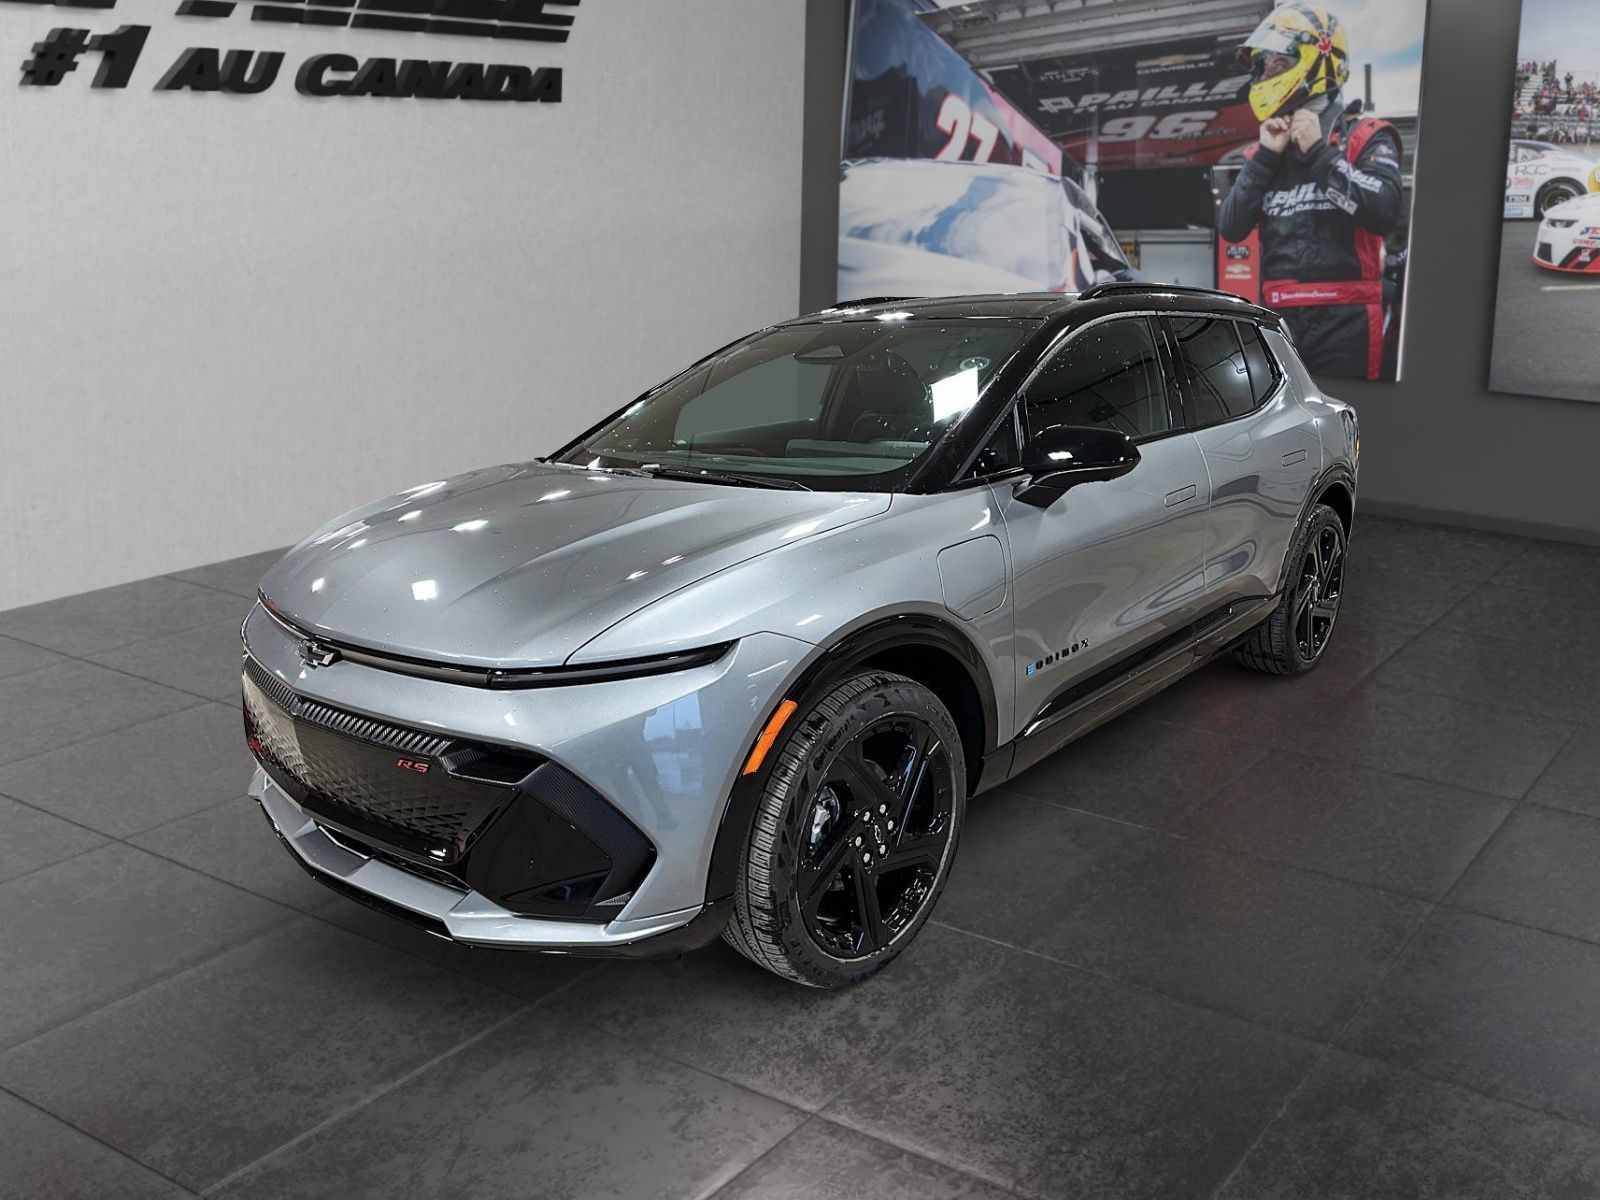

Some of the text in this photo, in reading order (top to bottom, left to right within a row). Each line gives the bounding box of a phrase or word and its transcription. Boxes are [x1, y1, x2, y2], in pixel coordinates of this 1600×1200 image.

[19, 25, 563, 103] #1 AU CANADA
[1074, 74, 1251, 108] PAILLE
[1103, 102, 1135, 112] AU
[1140, 93, 1238, 108] CANADA
[934, 93, 1000, 164] 27
[1098, 110, 1219, 143] 96
[1026, 637, 1089, 676] EQUINOX
[396, 758, 431, 774] RS
